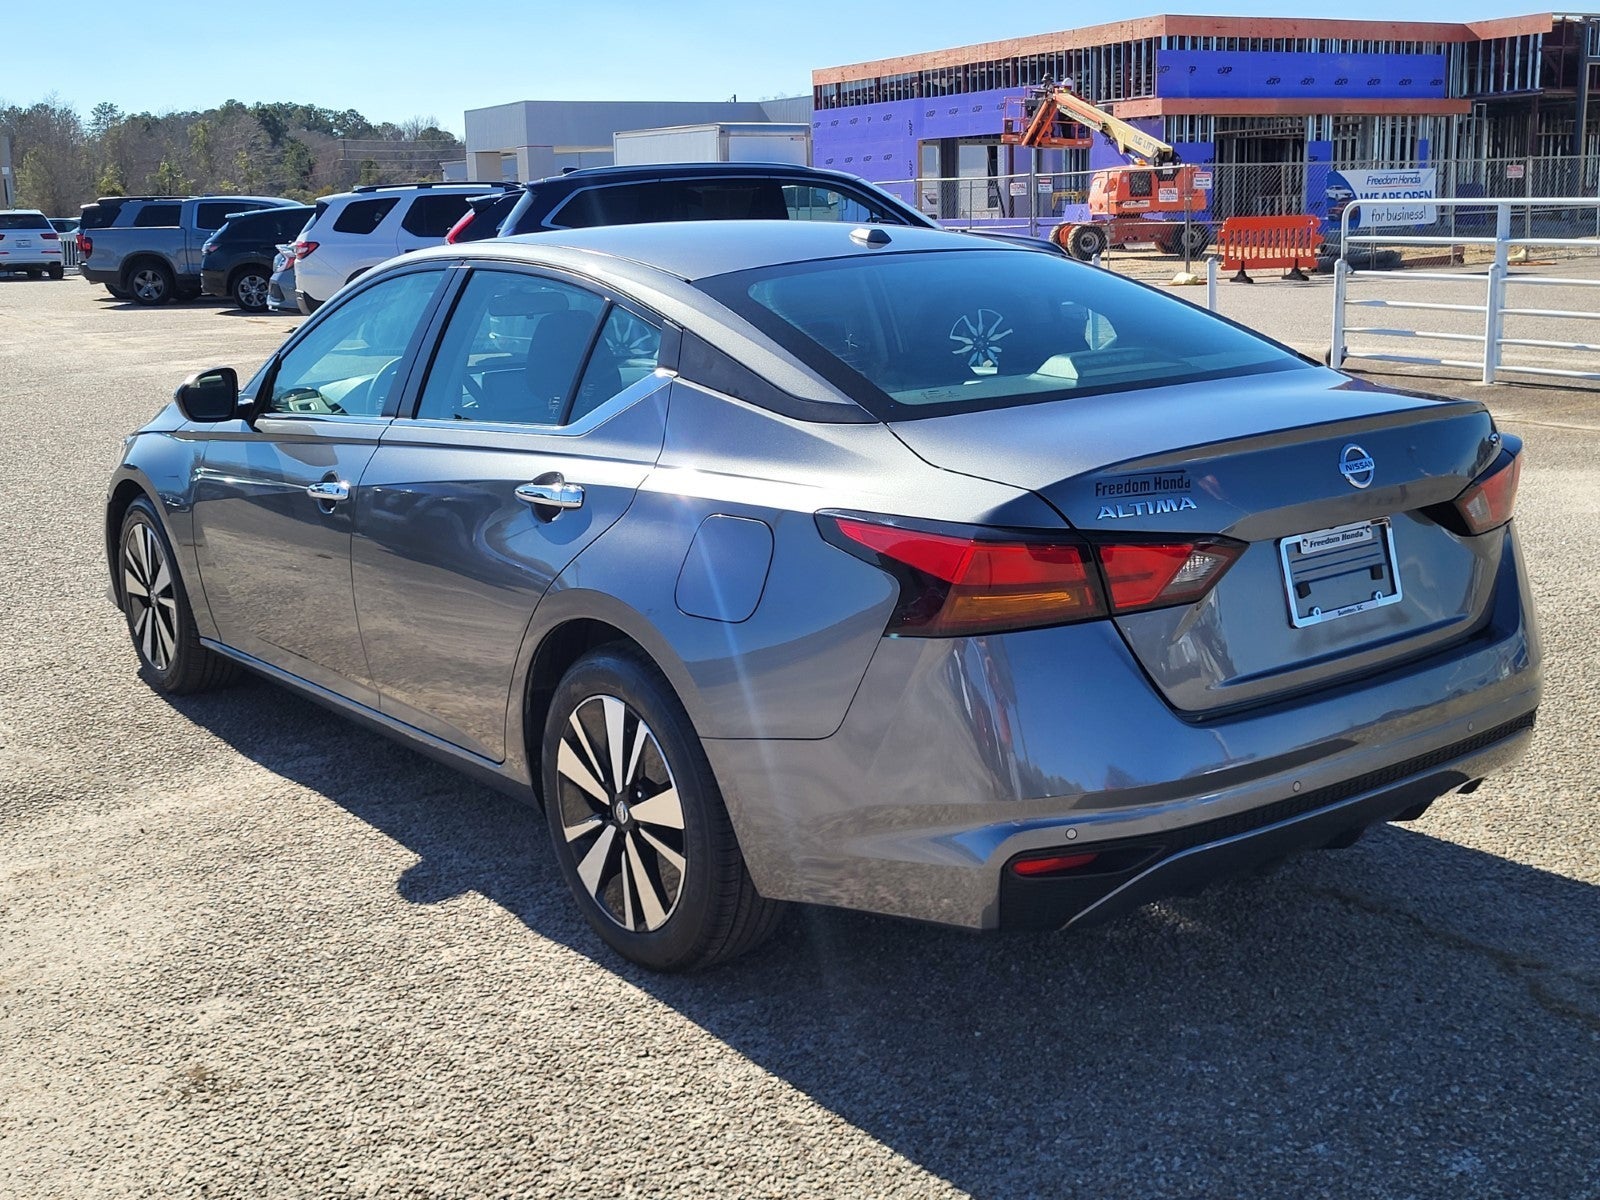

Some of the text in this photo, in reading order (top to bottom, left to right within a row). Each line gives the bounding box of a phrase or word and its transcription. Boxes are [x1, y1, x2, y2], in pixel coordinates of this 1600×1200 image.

[1366, 173, 1421, 186] Freedom Honda
[1371, 205, 1426, 223] for business!
[1345, 461, 1373, 471] NISSAN
[1095, 475, 1191, 497] Freedom Honda
[1097, 496, 1198, 520] ALTIMA
[1310, 530, 1364, 548] Freedom Honda
